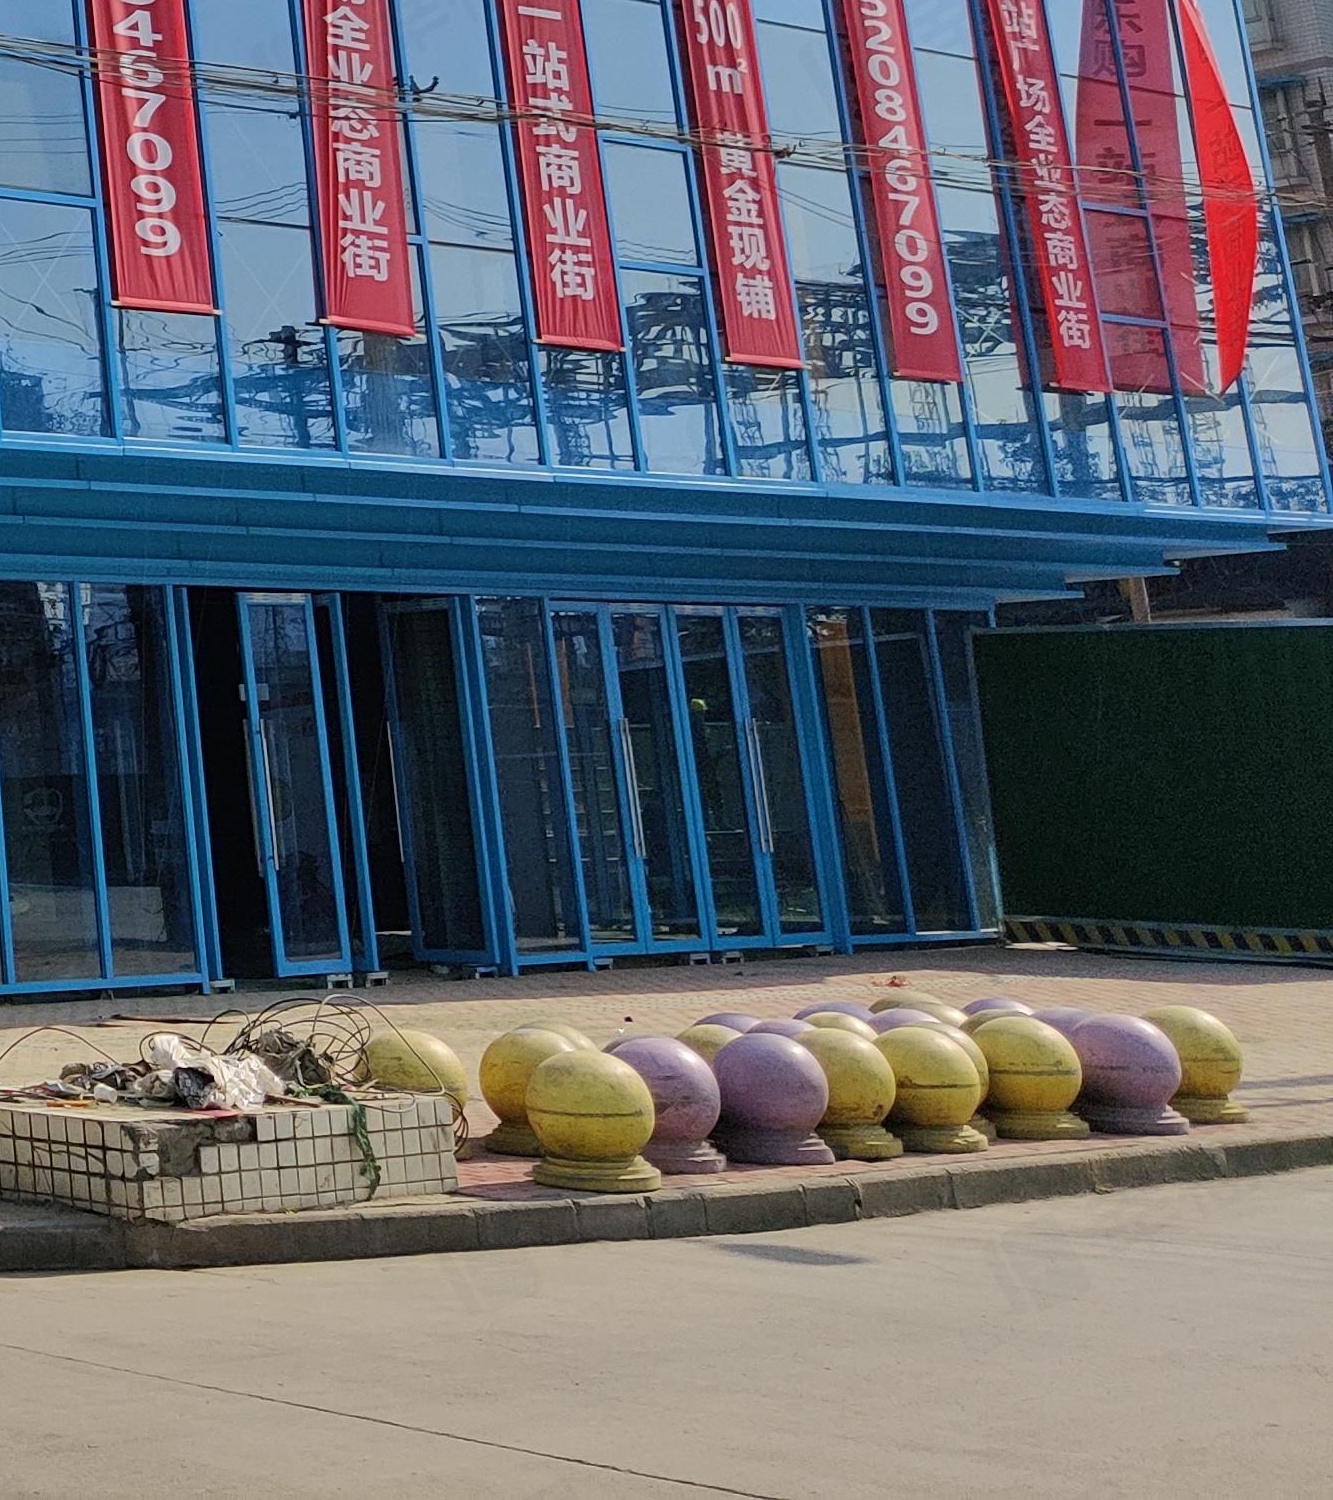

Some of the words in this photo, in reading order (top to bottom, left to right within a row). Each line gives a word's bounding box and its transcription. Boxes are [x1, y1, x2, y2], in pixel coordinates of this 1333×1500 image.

[518, 6, 595, 300] 一站式商业街
